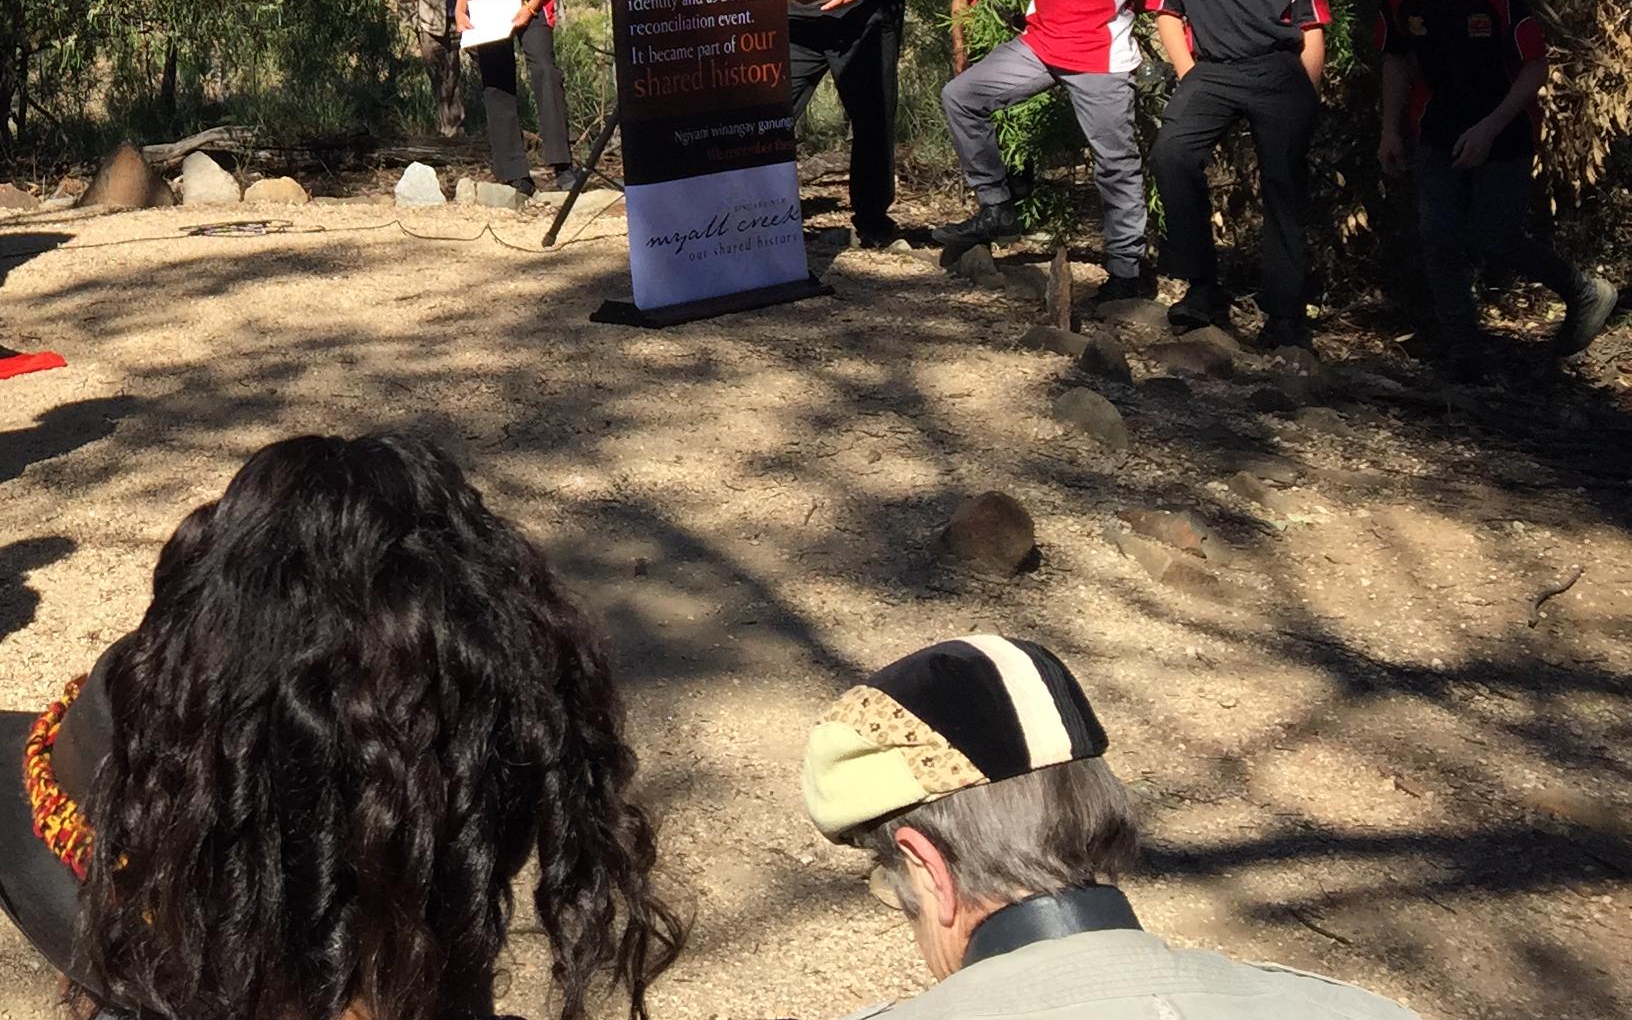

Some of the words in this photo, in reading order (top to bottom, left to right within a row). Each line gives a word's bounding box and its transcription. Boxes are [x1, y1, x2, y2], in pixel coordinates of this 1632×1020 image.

[629, 15, 714, 35] reconciliation
[718, 10, 754, 25] event.
[632, 47, 645, 64] It
[649, 43, 693, 63] became
[698, 41, 720, 57] part
[724, 35, 736, 53] of
[740, 30, 776, 52] our
[634, 60, 704, 98] shared
[646, 213, 730, 254] myall
[737, 205, 800, 232] creek
